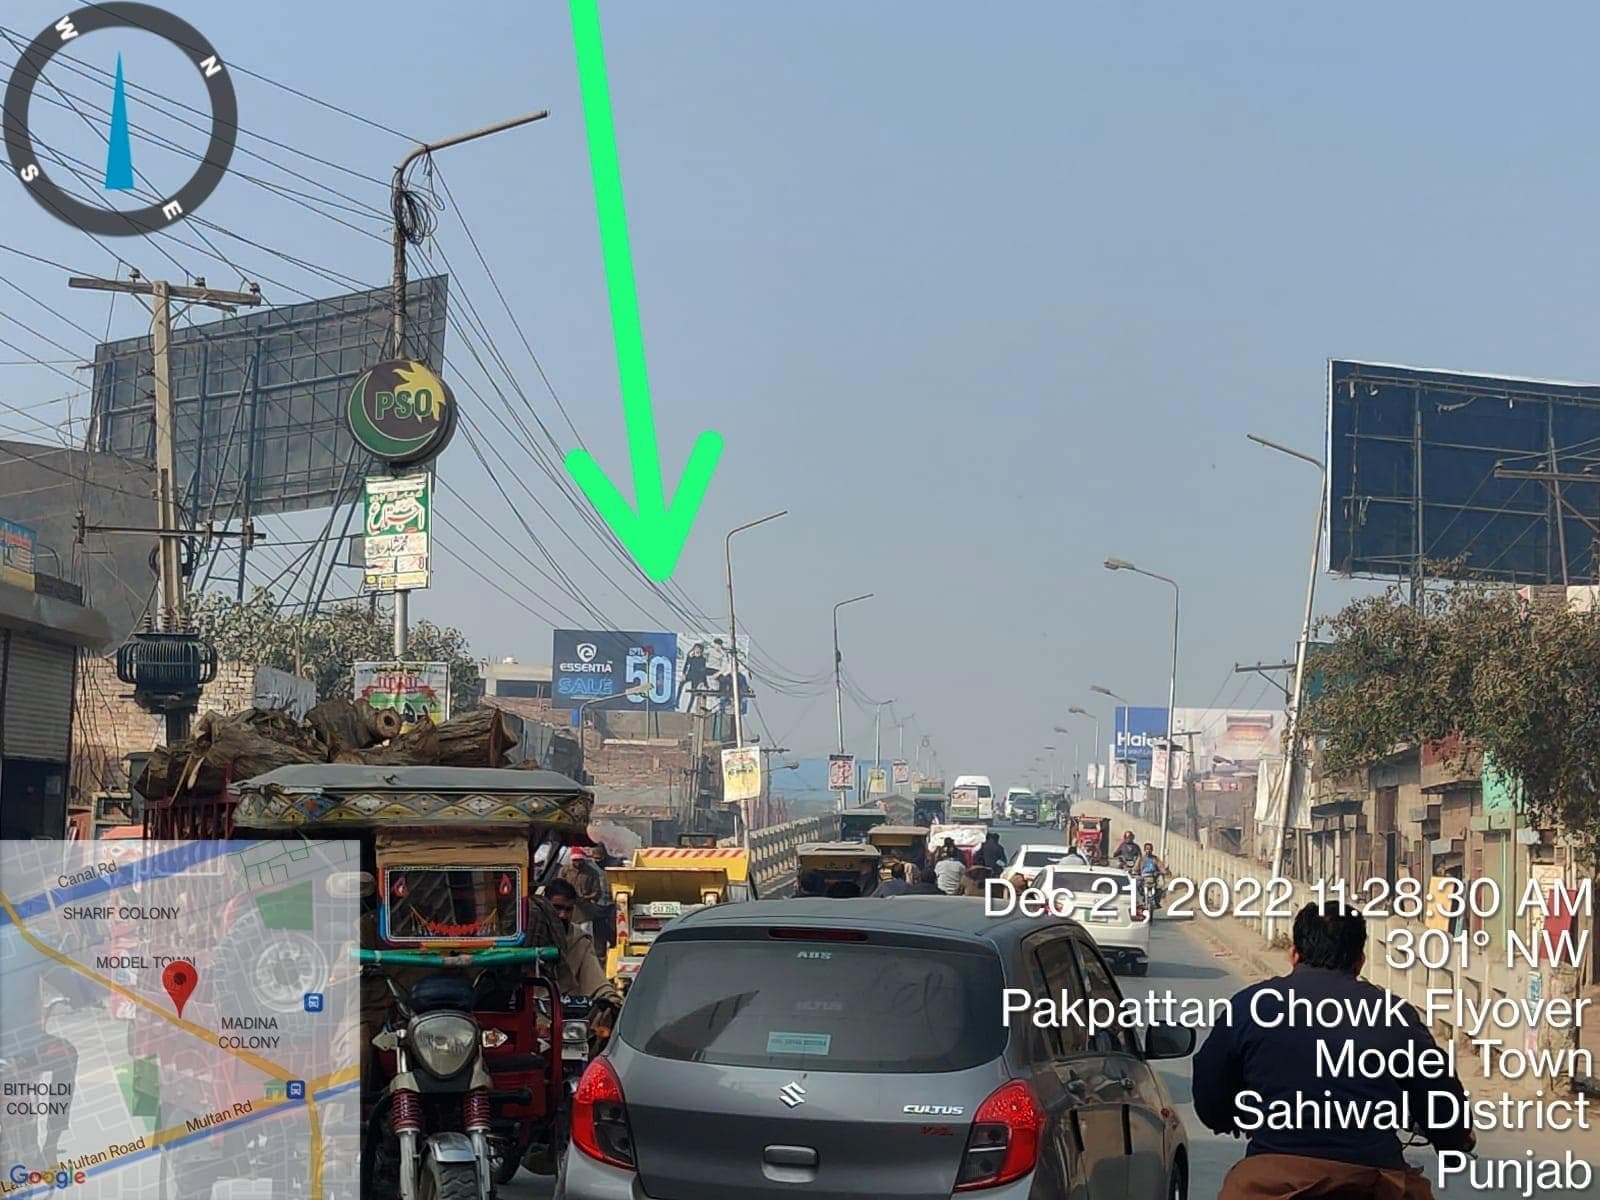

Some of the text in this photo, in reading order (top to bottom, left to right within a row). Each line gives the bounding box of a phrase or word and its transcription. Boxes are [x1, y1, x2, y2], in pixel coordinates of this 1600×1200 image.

[375, 389, 432, 420] PSO
[558, 678, 613, 695] SALE
[625, 655, 672, 704] 50
[903, 1104, 965, 1115] CULTUS
